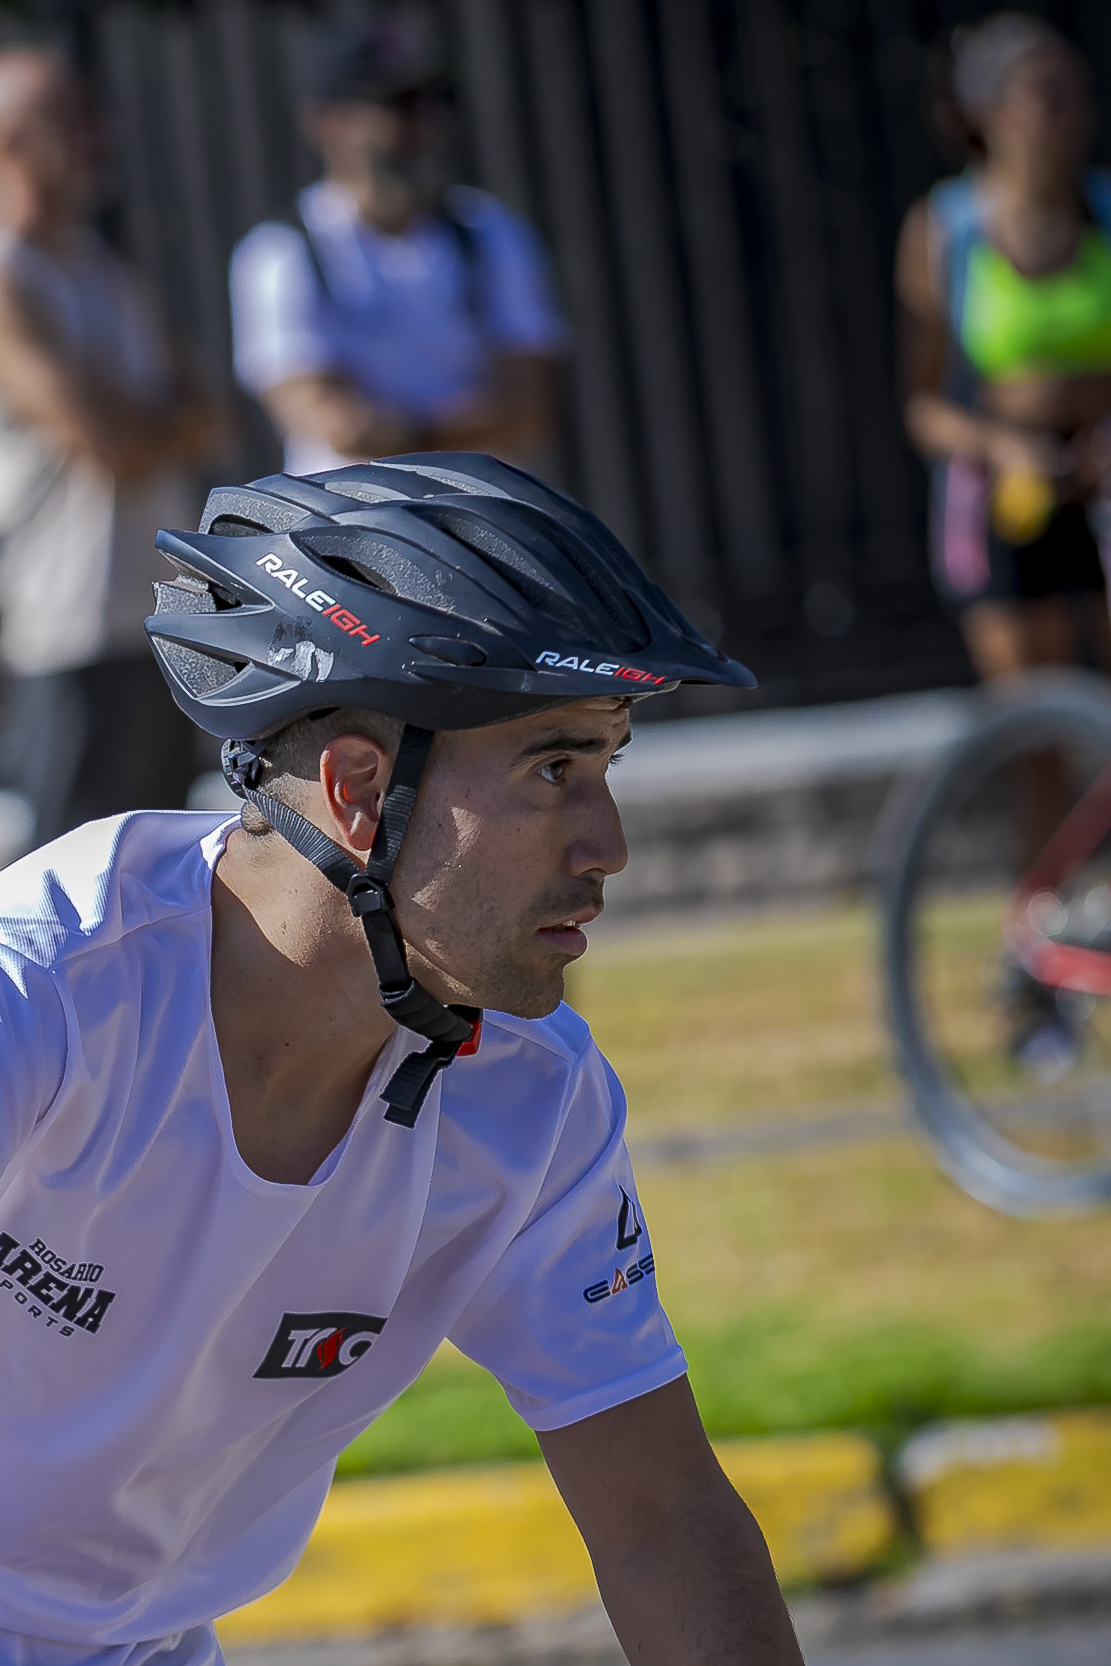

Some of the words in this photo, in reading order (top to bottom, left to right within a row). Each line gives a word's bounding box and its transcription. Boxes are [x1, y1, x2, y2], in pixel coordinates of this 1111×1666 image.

[255, 553, 381, 647] RALEIGH
[535, 651, 666, 685] RALEIGH
[28, 1237, 105, 1283] ROSARIO
